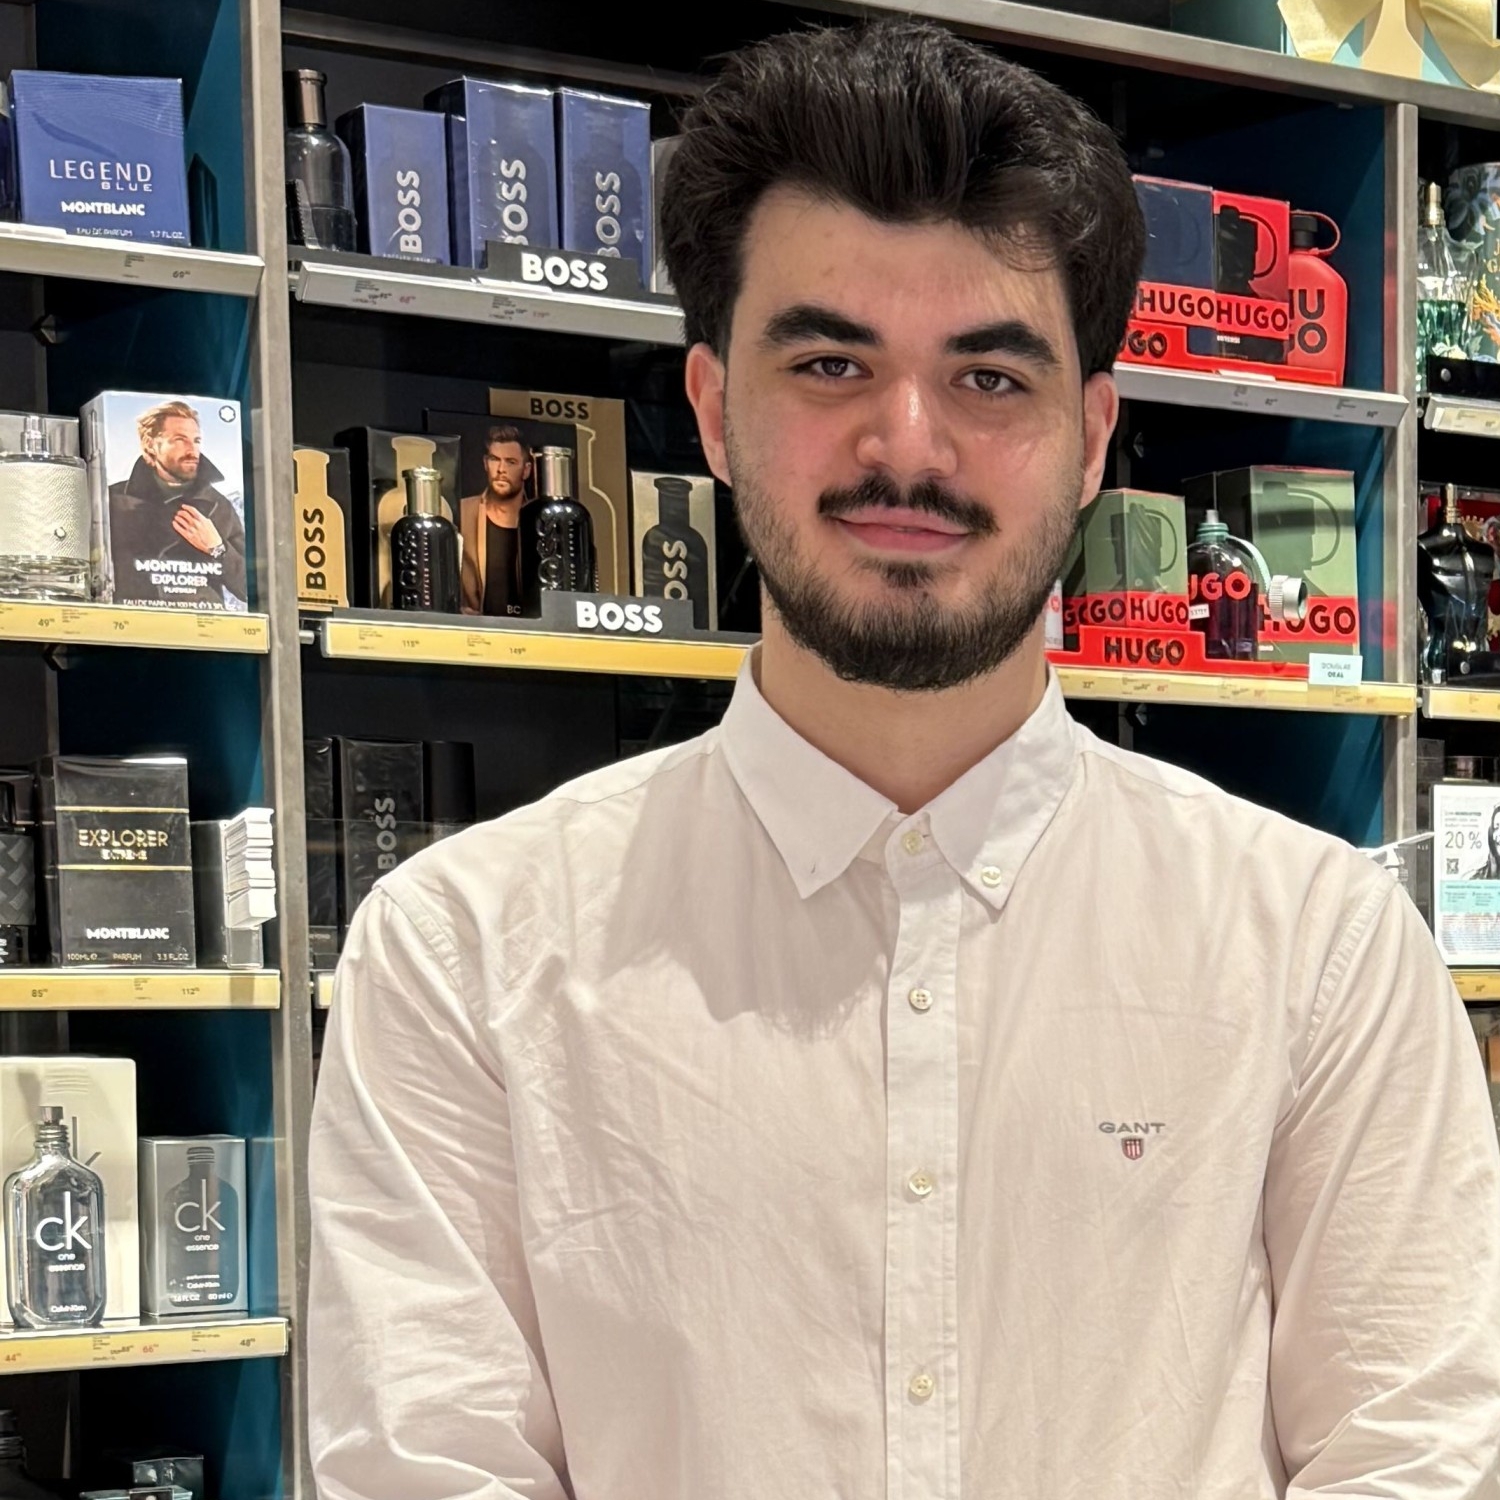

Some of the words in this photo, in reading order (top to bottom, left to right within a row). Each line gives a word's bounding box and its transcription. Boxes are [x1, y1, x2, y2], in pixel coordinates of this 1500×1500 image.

[50, 159, 151, 182] LEGEND
[101, 182, 152, 192] BLUE
[61, 201, 145, 216] MONTBLANC
[396, 170, 422, 254] BOSS
[521, 251, 609, 292] BOSS
[1138, 288, 1215, 320] HUGO
[1216, 298, 1290, 332] HUGO
[530, 397, 590, 420] BOSS
[302, 507, 327, 591] BOSS
[135, 560, 222, 575] MONTBLANC
[151, 574, 208, 586] EXPLORER
[164, 586, 196, 594] PLATINUM
[576, 600, 663, 633] BOSS
[1130, 597, 1188, 625] HUGO
[1104, 636, 1185, 665] HUGO
[78, 829, 169, 848] EXPLORER
[374, 797, 397, 870] BOSS
[1445, 831, 1465, 849] 20
[1469, 831, 1482, 849] %
[86, 928, 169, 940] MONTBLANC
[112, 953, 142, 961] PARFUM
[1098, 1121, 1166, 1134] GANT
[174, 1178, 226, 1232] ck
[35, 1191, 92, 1251] ck
[194, 1233, 211, 1241] one
[58, 1252, 75, 1261] one
[186, 1243, 220, 1251] essence
[49, 1262, 86, 1272] essence
